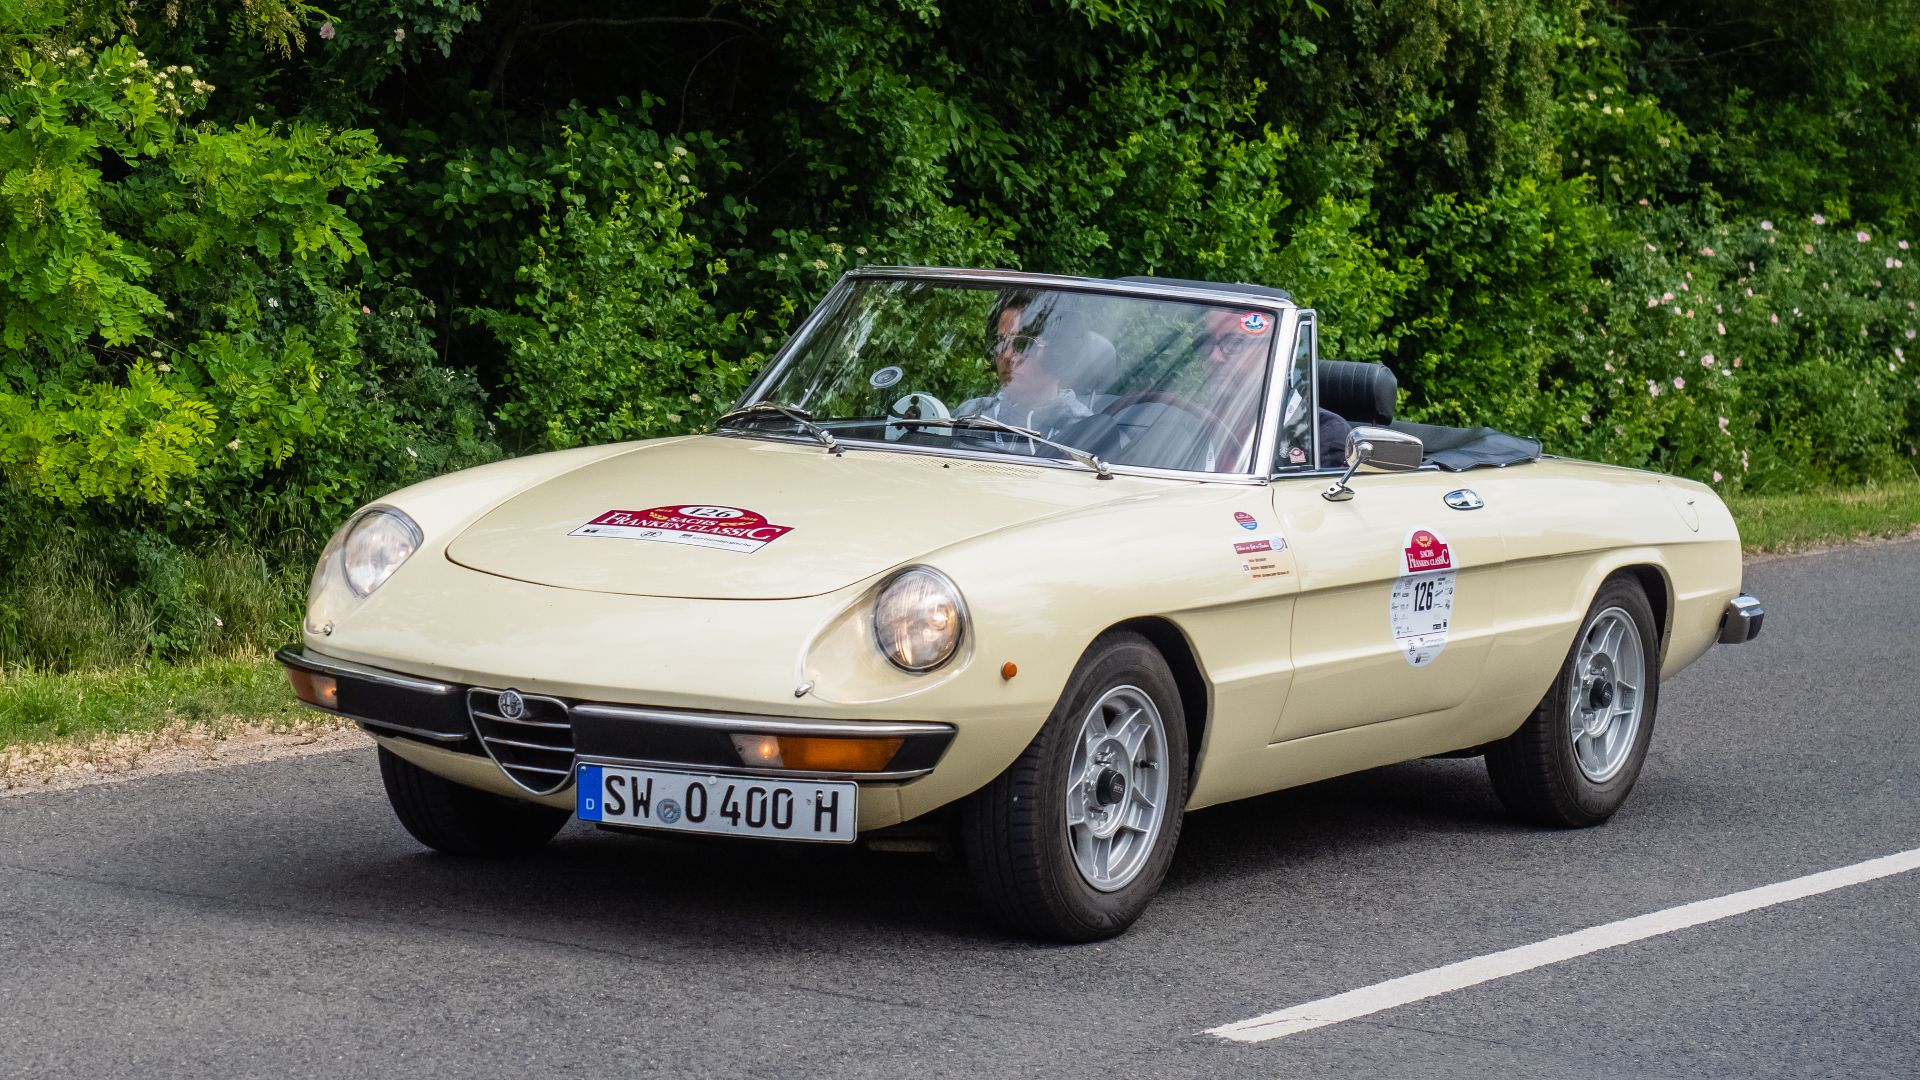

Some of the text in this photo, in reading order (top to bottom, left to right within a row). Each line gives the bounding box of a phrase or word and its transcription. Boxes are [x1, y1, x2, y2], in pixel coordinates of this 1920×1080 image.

[688, 508, 735, 518] 126
[597, 511, 782, 540] FRANKEN CLASSIC
[667, 516, 719, 526] SACHS
[1419, 549, 1434, 558] SACHS
[1430, 548, 1449, 566] CLASSIC
[1414, 580, 1434, 612] 126
[585, 798, 595, 810] D
[604, 774, 653, 818] SW
[720, 784, 794, 830] 400
[814, 790, 839, 833] H
